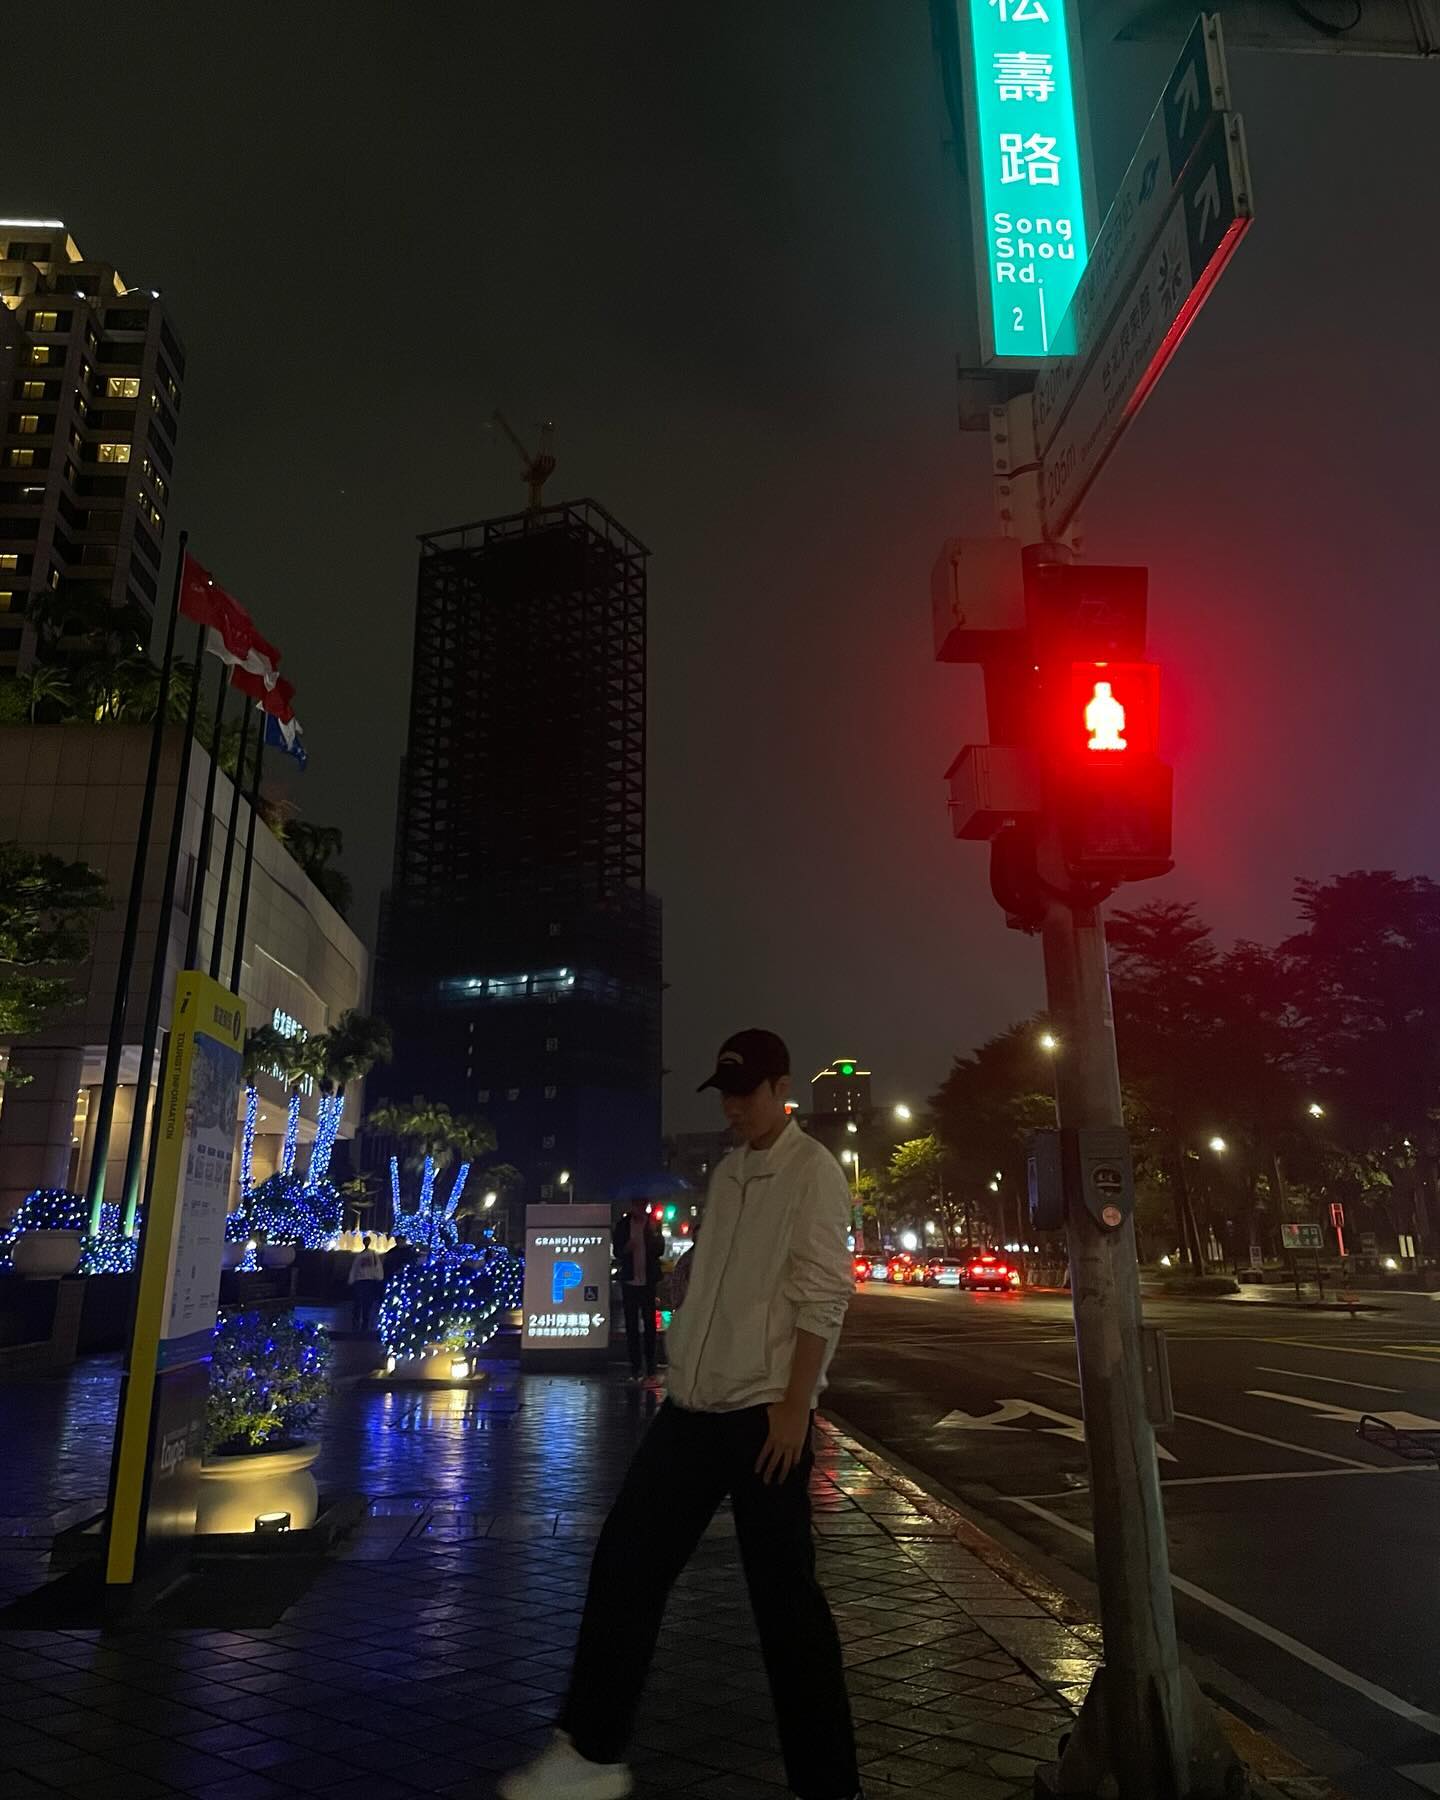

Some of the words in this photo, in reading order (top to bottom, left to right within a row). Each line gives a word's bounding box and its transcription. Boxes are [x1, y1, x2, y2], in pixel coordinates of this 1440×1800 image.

[994, 213, 1073, 240] Song
[996, 238, 1075, 260] Shou
[997, 262, 1044, 284] Rd.
[1013, 306, 1025, 331] 2
[535, 1237, 568, 1246] GRAND
[571, 1237, 603, 1245] HYATT
[552, 1260, 583, 1304] P
